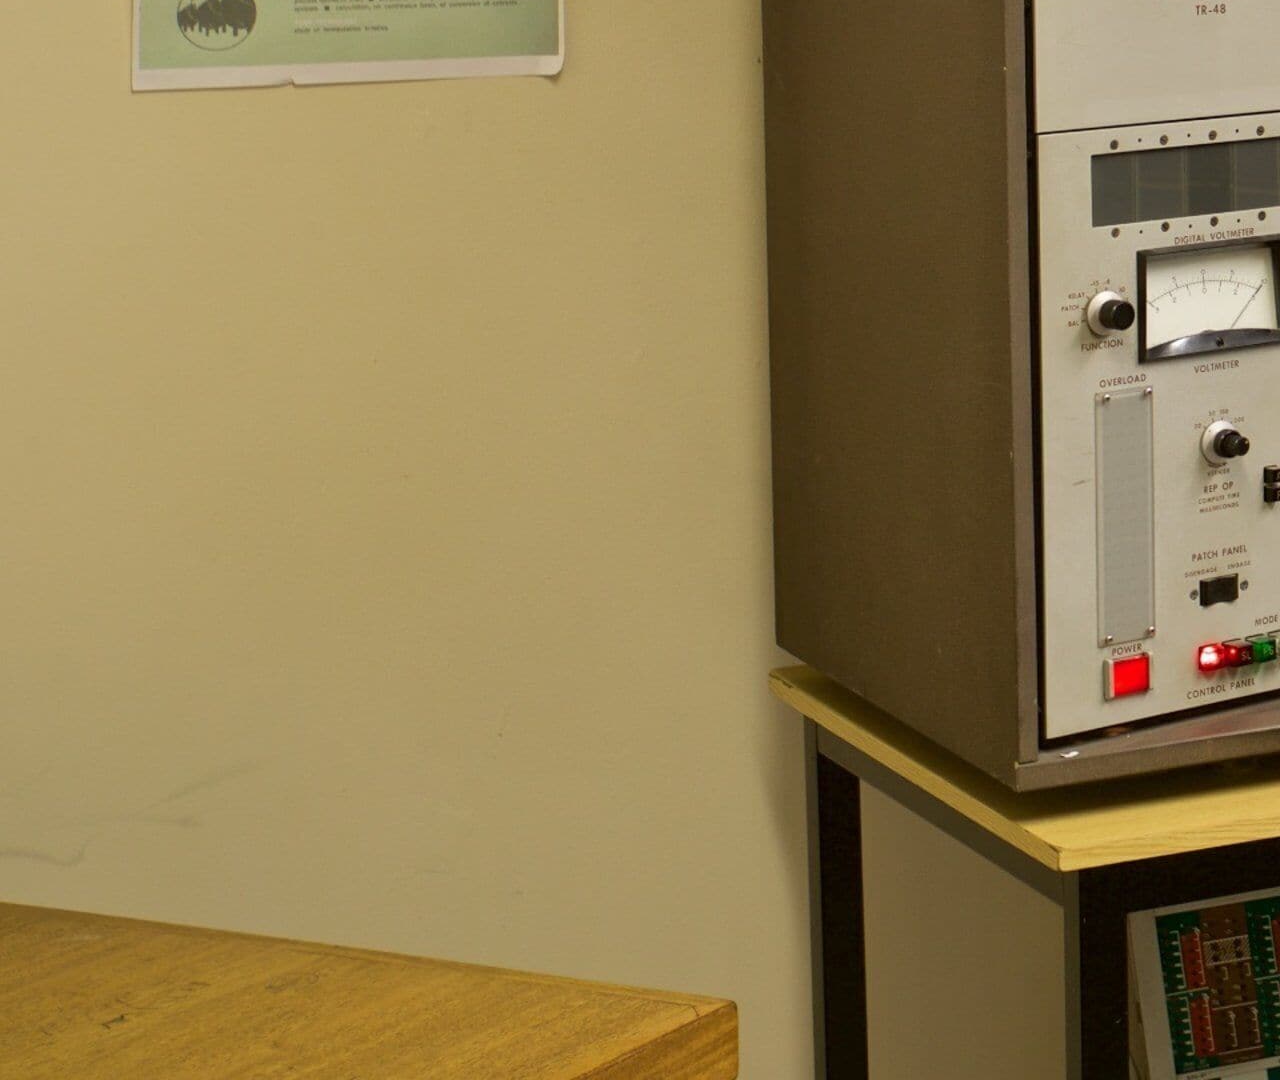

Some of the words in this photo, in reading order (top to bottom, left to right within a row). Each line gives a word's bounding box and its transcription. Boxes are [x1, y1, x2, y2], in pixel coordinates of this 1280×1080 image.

[1196, 3, 1226, 16] TR-48
[1174, 235, 1205, 245] DIGITAL
[1210, 227, 1254, 241] VOLTMETER
[1081, 339, 1123, 352] FUNCTION
[1194, 360, 1239, 373] VOLTMETER
[1099, 373, 1147, 388] OVERLOAD
[1204, 484, 1220, 493] REP
[1223, 481, 1234, 491] OP
[1192, 550, 1218, 562] PATCH
[1222, 544, 1247, 556] PANEL
[1255, 615, 1279, 626] MODE
[1112, 643, 1143, 655] POWER
[1187, 685, 1226, 699] CONTROL
[1230, 678, 1255, 692] PANEL
